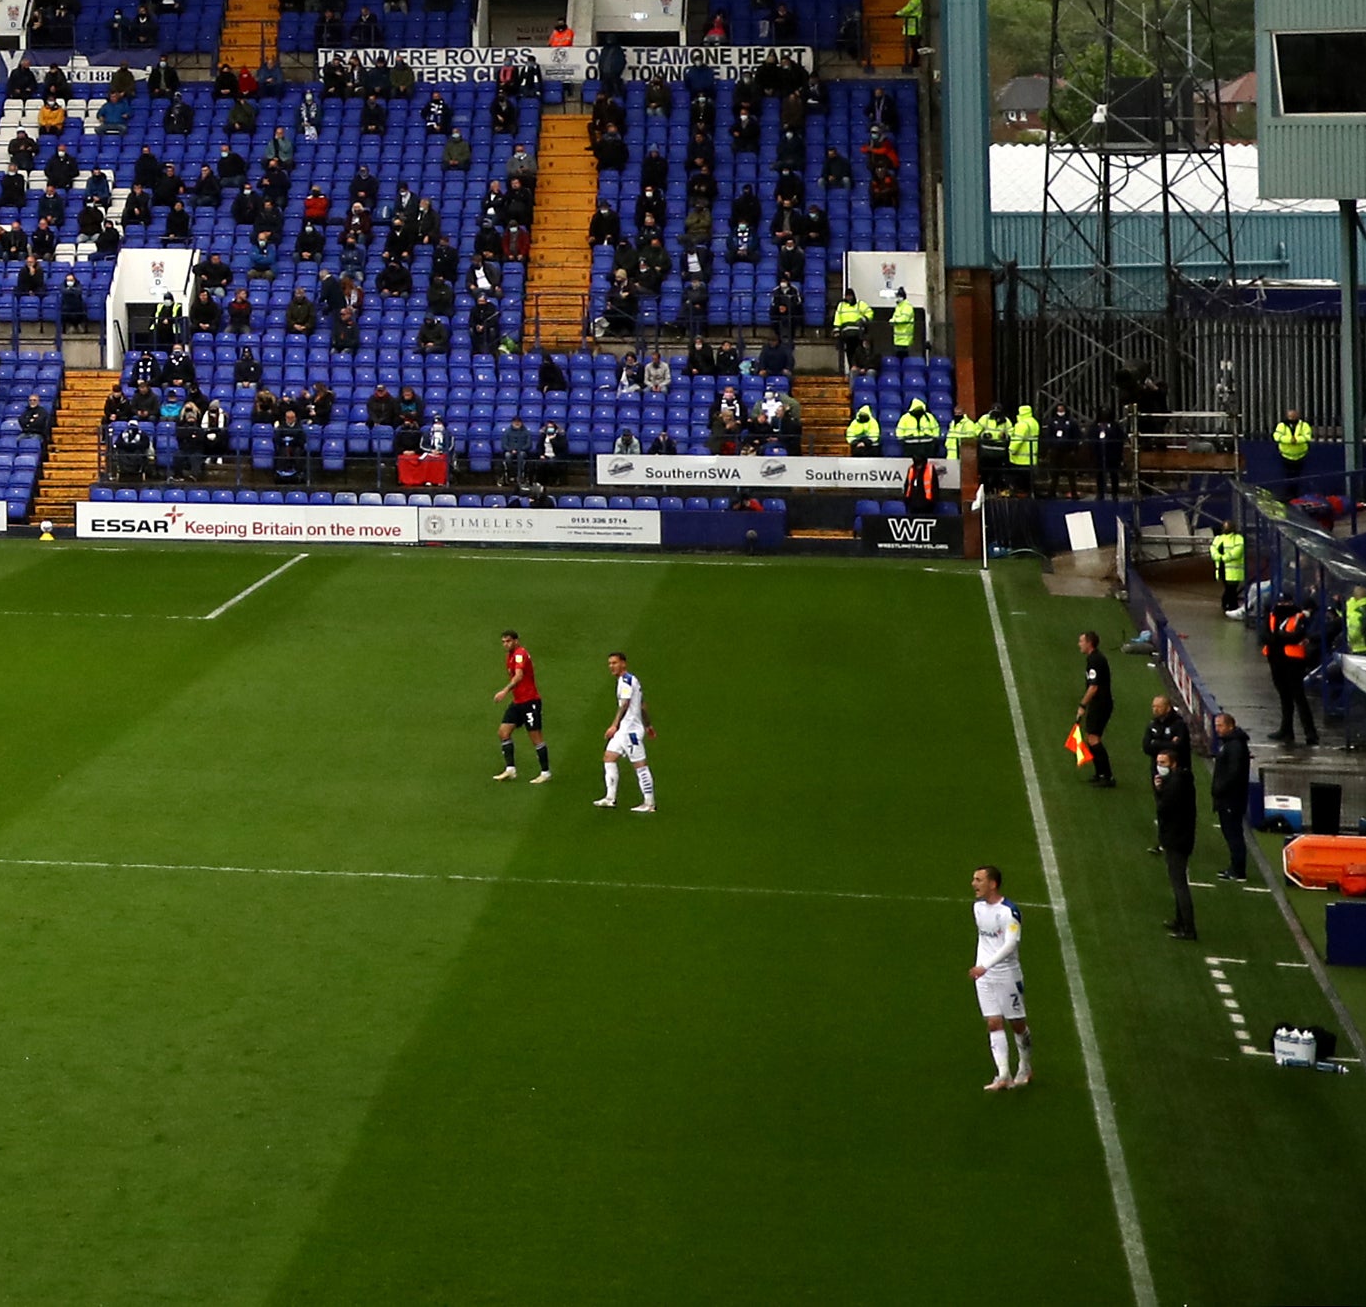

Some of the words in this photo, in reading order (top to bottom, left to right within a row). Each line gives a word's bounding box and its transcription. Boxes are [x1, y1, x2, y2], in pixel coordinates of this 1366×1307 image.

[634, 49, 690, 64] TEAM
[645, 467, 742, 480] SouthernSWA
[805, 469, 904, 482] SouthernSWA
[91, 519, 169, 533] ESSAR
[185, 520, 247, 537] Keeping
[252, 521, 303, 536] Britain
[307, 526, 327, 536] on
[330, 523, 355, 536] the
[359, 526, 402, 537] move
[450, 518, 534, 528] TIMELESS
[888, 518, 937, 541] WT
[526, 713, 533, 723] 3
[628, 745, 634, 754] 7
[1010, 994, 1020, 1007] 2
